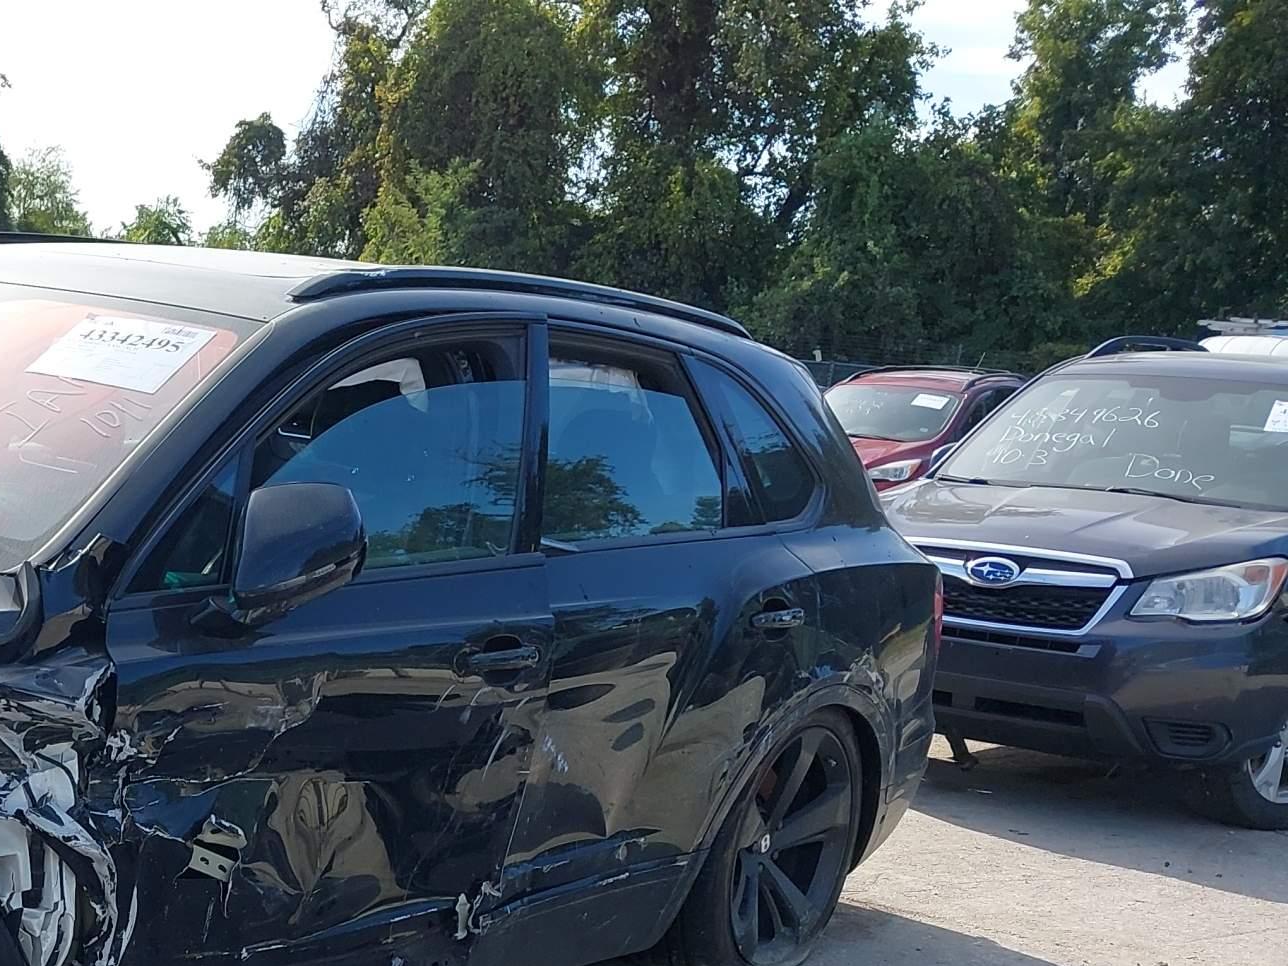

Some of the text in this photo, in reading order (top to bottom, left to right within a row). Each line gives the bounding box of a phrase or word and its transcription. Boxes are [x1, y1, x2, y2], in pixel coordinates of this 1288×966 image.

[79, 329, 185, 353] 43342495
[999, 426, 1116, 452] Donegal
[1123, 452, 1216, 490] Done
